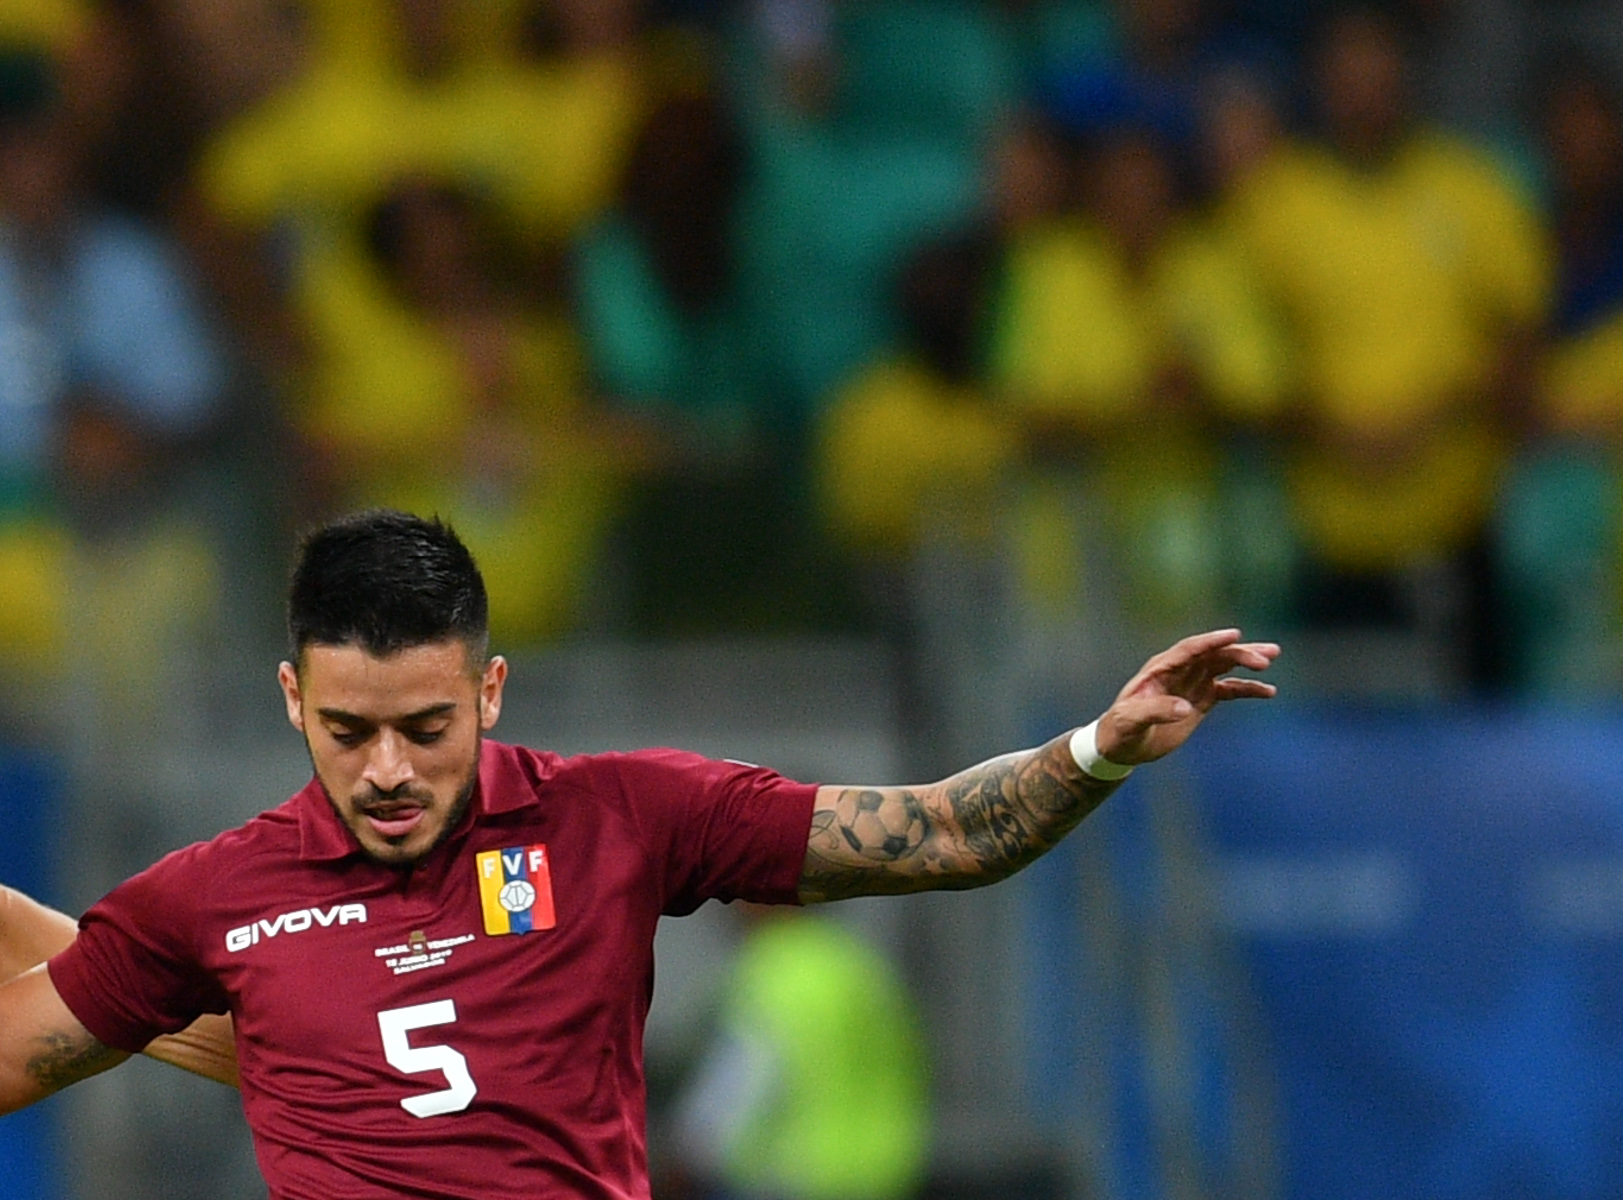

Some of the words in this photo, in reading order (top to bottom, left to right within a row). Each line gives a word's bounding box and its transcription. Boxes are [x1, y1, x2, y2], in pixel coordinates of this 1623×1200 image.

[482, 850, 544, 879] FVF
[225, 903, 367, 953] GIVOVA
[377, 999, 477, 1118] 5
